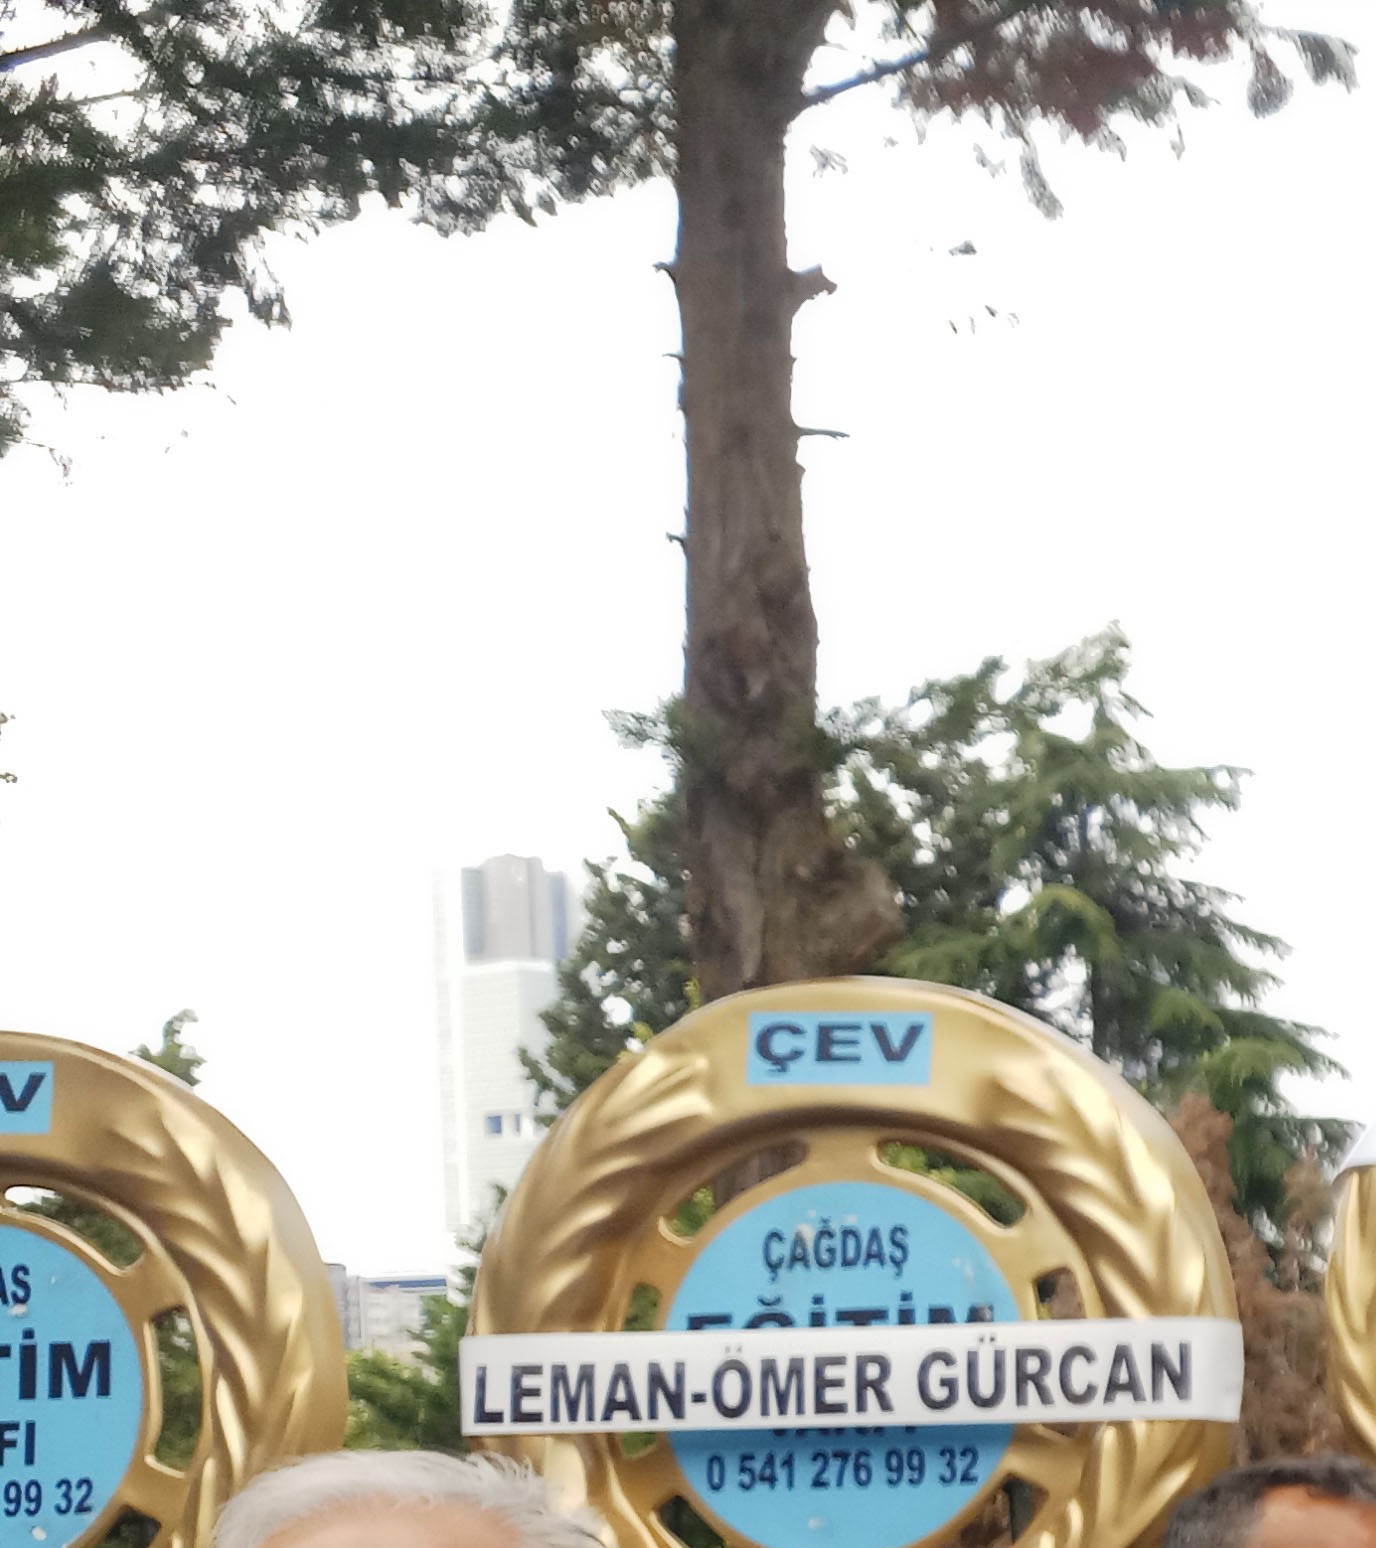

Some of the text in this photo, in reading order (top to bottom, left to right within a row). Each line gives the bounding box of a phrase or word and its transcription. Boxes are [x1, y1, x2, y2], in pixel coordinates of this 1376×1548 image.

[754, 1022, 925, 1073] ÇEV
[762, 1217, 910, 1283] ÇAĞDAŞ
[472, 1334, 1192, 1424] LEMAN-ÖMER GÜRCAN
[707, 1446, 979, 1491] 0 541 276 99 32
[3, 1476, 94, 1517] 99 32
